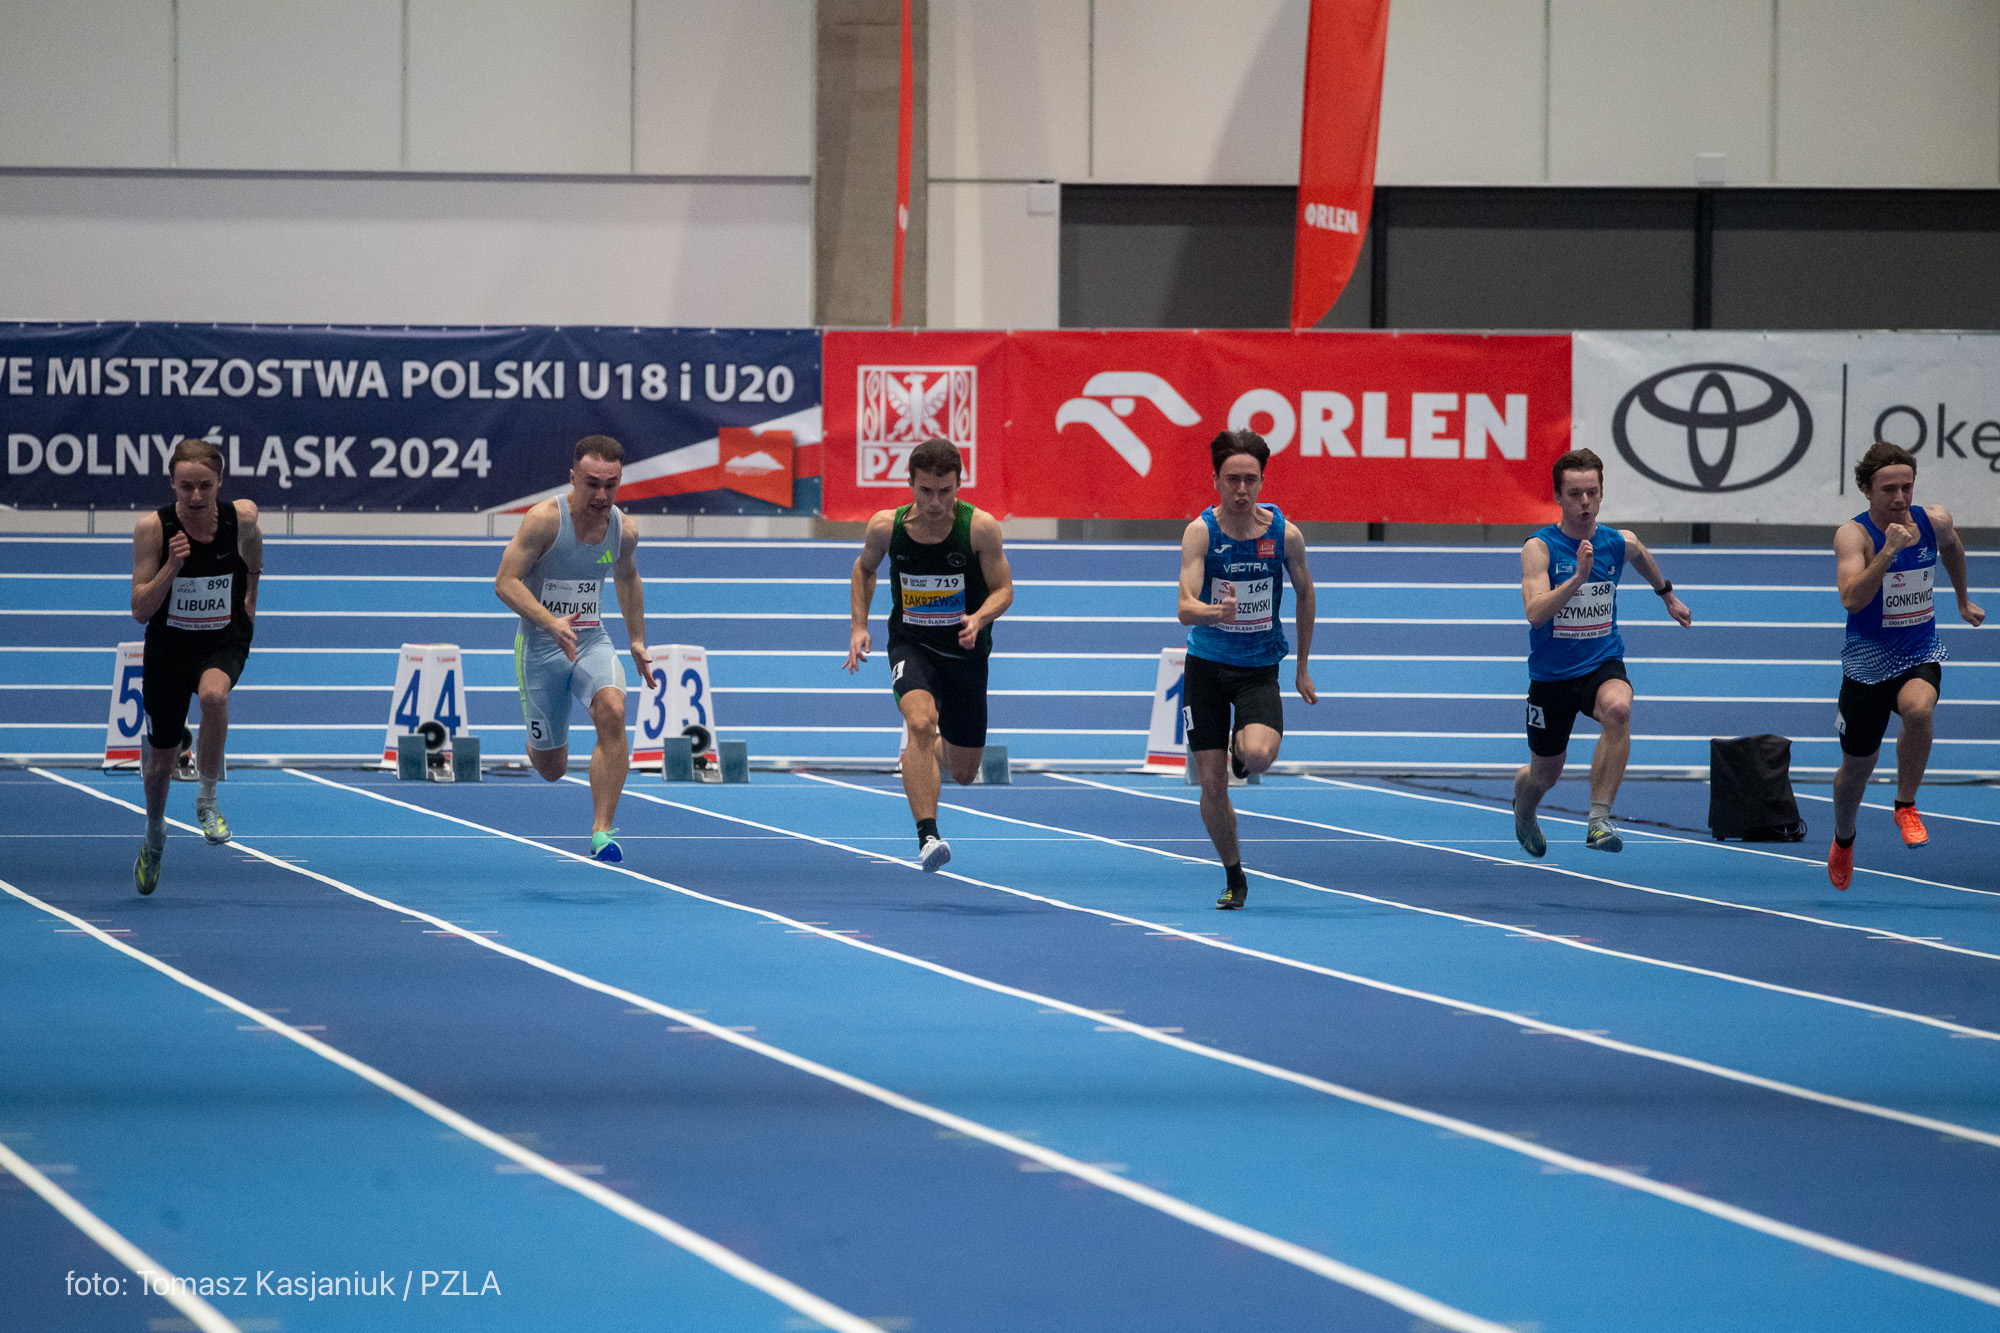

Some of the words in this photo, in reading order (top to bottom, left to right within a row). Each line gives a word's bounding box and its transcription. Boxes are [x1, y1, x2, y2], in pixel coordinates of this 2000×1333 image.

[1304, 202, 1359, 235] ORLEN
[0, 356, 34, 396] E
[46, 356, 389, 399] MISTRZOSTWA
[402, 359, 565, 400] POLSKI
[578, 360, 668, 401] U18
[680, 362, 692, 402] i
[704, 363, 795, 404] U20
[1227, 387, 1528, 461] ORLEN
[7, 432, 185, 476] DOLNY
[201, 425, 358, 490] LĄSK
[369, 436, 493, 479] 2024
[863, 446, 969, 480] PZ
[1223, 562, 1269, 573] VECTRA
[207, 578, 230, 591] 890
[577, 582, 597, 594] 534
[934, 578, 959, 588] 719
[1247, 580, 1269, 594] 166
[1591, 583, 1611, 597] 368
[177, 598, 226, 611] LIBURA
[904, 593, 964, 608] ZAKRZEWSKI
[1885, 588, 1933, 608] GONKIEWICZ
[117, 665, 145, 738] 5
[394, 669, 421, 734] 4
[434, 669, 461, 741] 4
[643, 668, 667, 740] 3
[681, 668, 706, 728] 3
[1165, 672, 1185, 745] 1
[1530, 707, 1542, 726] 2
[530, 721, 543, 740] 5
